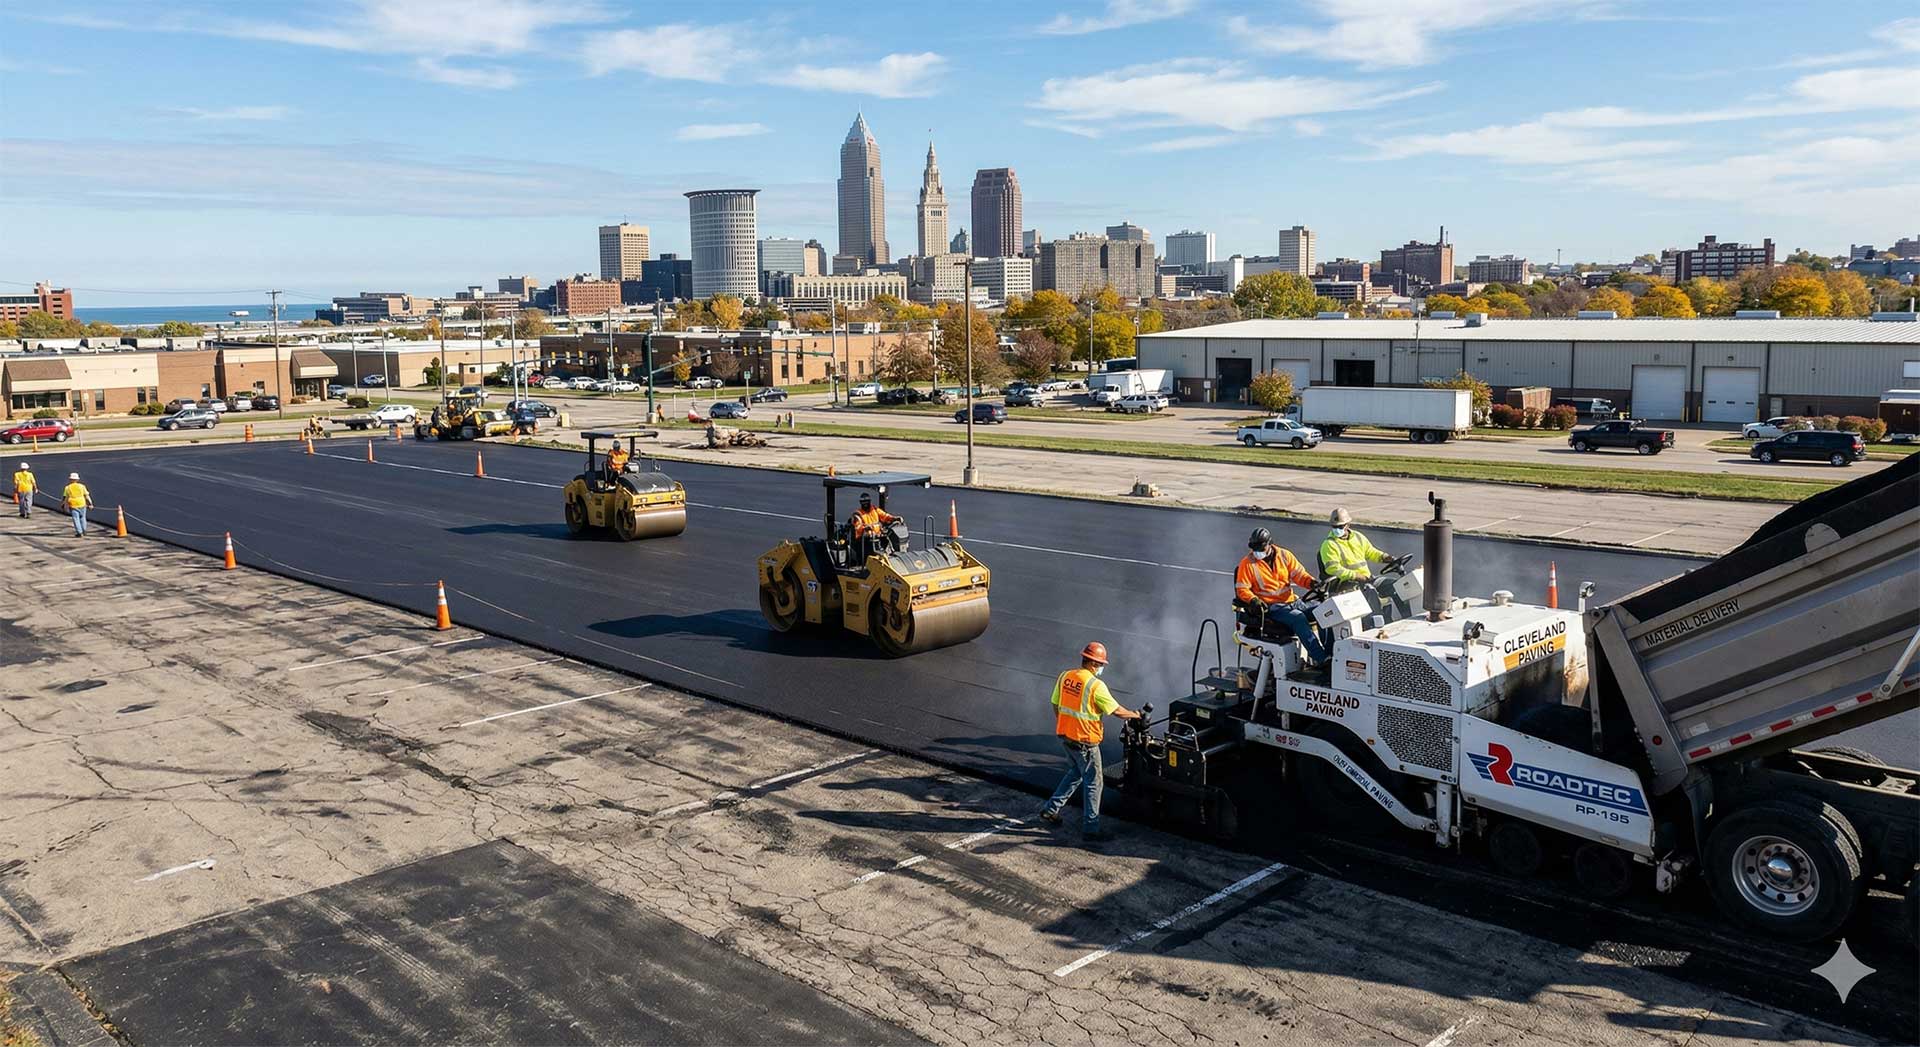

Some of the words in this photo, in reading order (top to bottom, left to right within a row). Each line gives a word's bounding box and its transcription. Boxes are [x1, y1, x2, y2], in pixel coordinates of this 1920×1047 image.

[1644, 619, 1694, 647] MATERIAL
[1692, 599, 1740, 627] DELIVERY
[1504, 621, 1566, 653] CLEVELAND
[1519, 641, 1554, 665] PAVING
[1064, 678, 1082, 691] CLE
[1289, 686, 1360, 709] CLEVELAND
[1306, 702, 1344, 718] PAVING
[1516, 766, 1631, 804] ROADTEC
[1370, 786, 1394, 809] PAVING
[1575, 804, 1630, 824] RP-195
